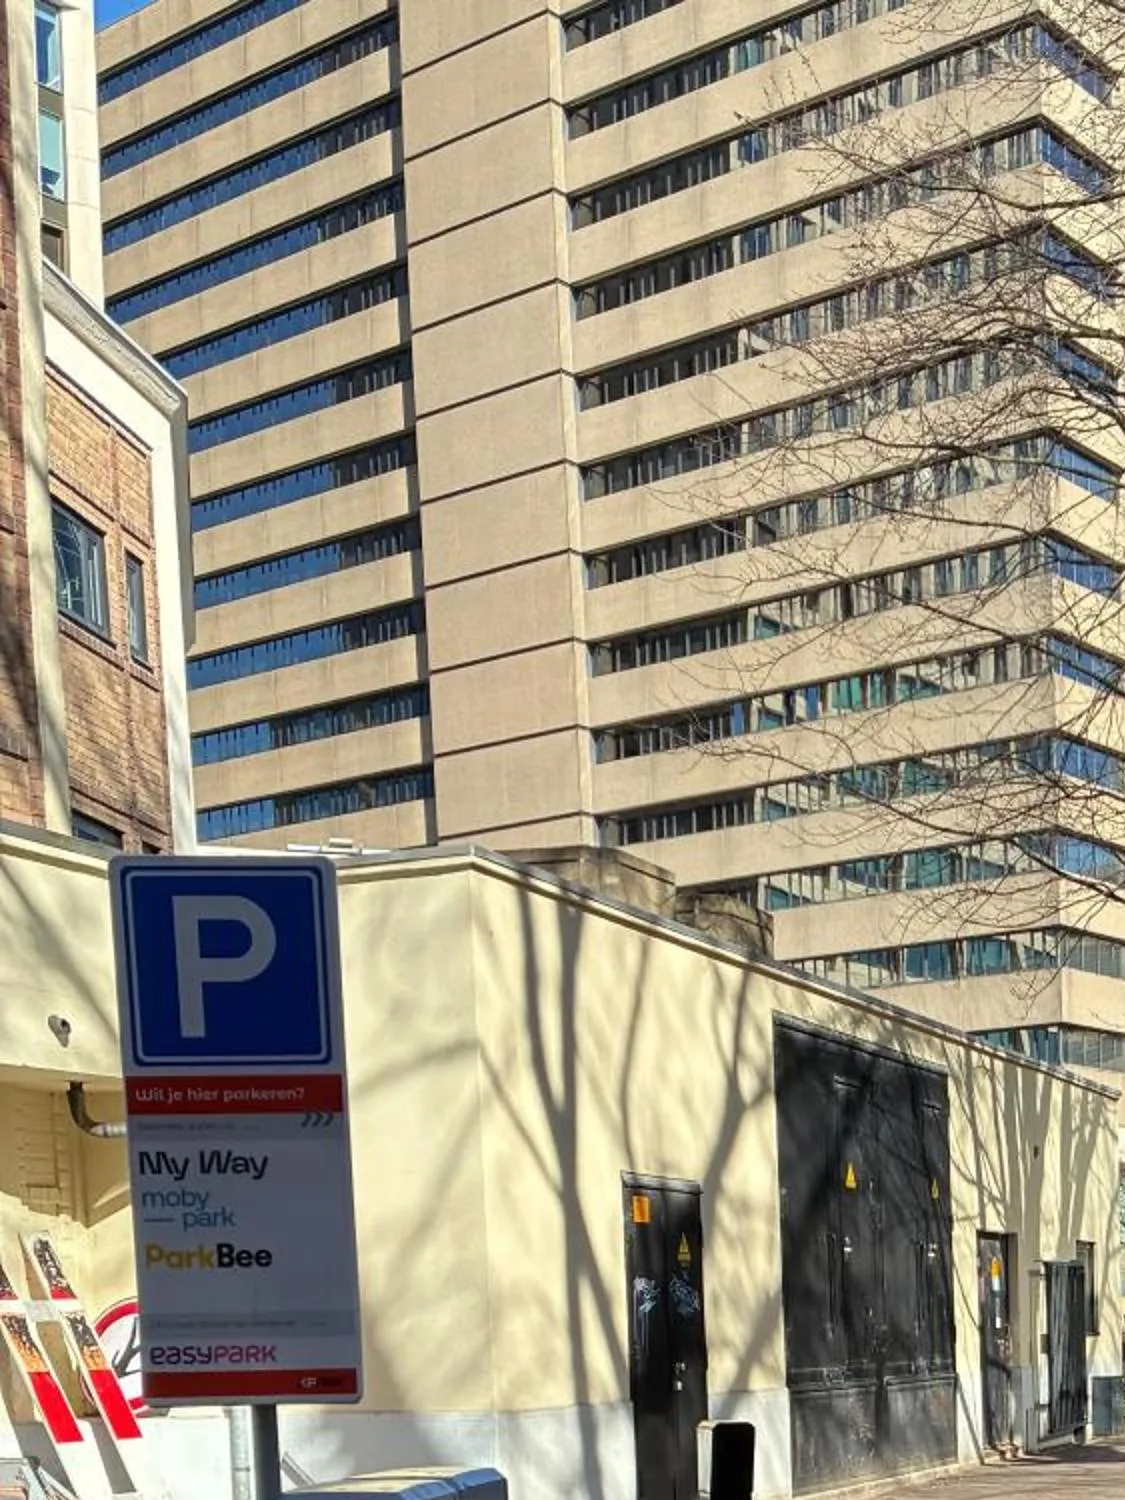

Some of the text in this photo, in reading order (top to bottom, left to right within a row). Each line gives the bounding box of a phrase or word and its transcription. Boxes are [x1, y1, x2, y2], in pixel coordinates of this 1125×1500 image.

[171, 896, 277, 1037] P
[187, 1087, 218, 1100] hier
[138, 1149, 268, 1181] My Way
[142, 1187, 209, 1211] moby
[182, 1207, 236, 1231] park
[145, 1243, 272, 1268] ParkBee
